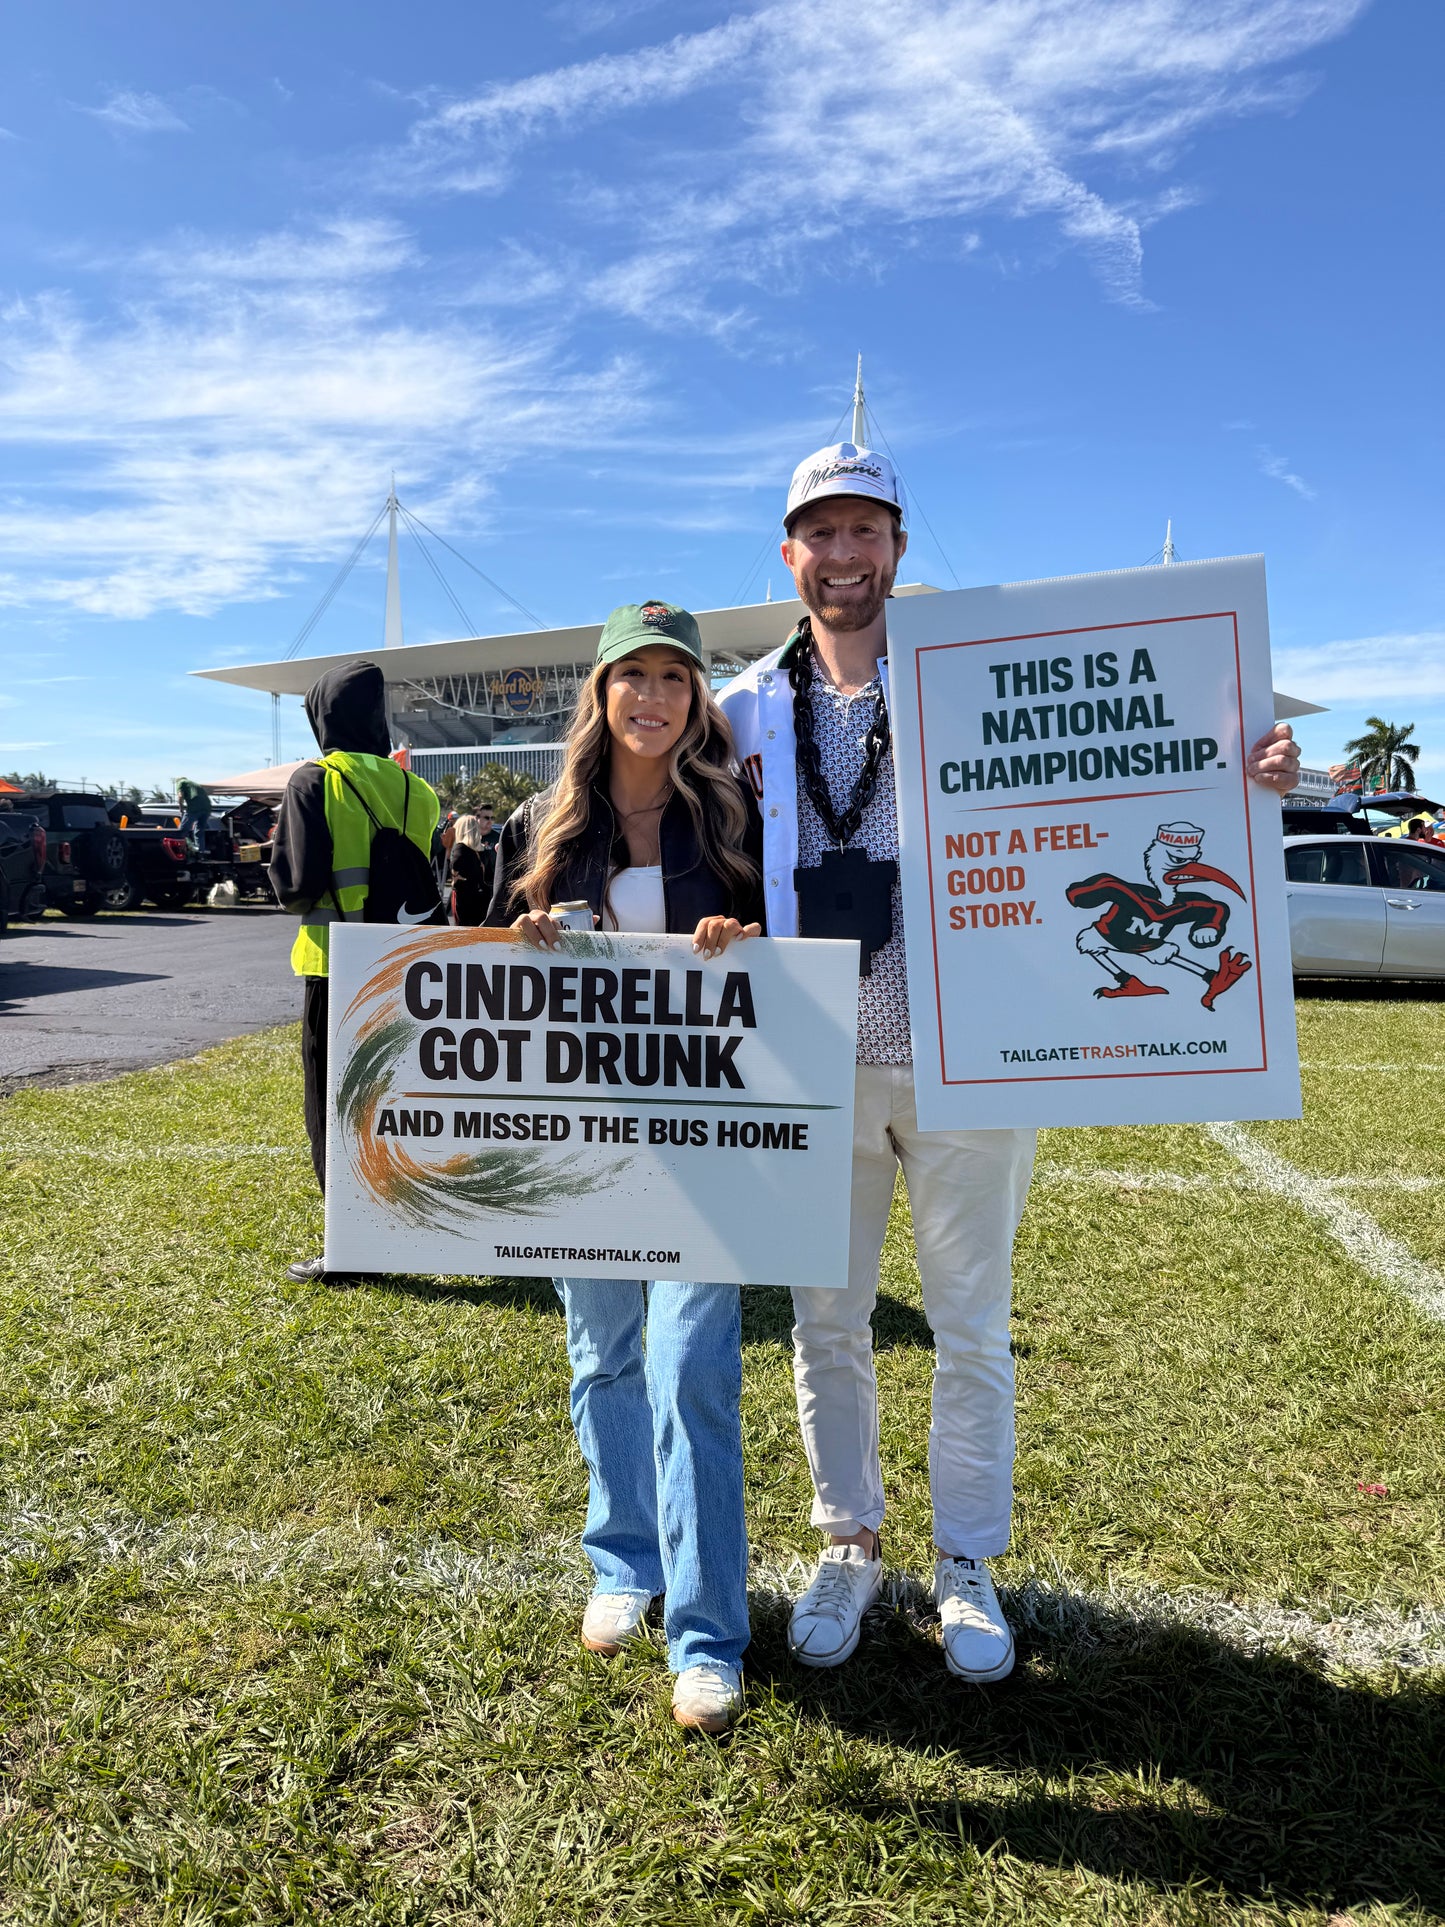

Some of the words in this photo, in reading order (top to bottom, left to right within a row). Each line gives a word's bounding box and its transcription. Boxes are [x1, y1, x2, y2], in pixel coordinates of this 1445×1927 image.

[491, 678, 517, 695] Hard
[518, 676, 544, 697] Rock
[989, 656, 1074, 699] THIS
[1083, 651, 1120, 690] IS
[1128, 647, 1157, 685] A
[981, 693, 1175, 746] NATIONAL
[939, 737, 1227, 795] CHAMPIONSHIP.
[945, 831, 1000, 859] NOT
[1008, 829, 1027, 854] A
[1034, 823, 1110, 852] FEEL-
[1159, 831, 1199, 845] MIAMI
[947, 866, 1025, 896] GOOD
[949, 900, 1042, 930] STORY.
[1125, 916, 1164, 939] M
[404, 961, 758, 1029] CINDERELLA
[419, 1026, 531, 1083] GOT
[545, 1030, 746, 1090] DRUNK
[999, 1040, 1228, 1064] TAILGATETRASHTALK.COM
[376, 1109, 444, 1138] AND
[453, 1111, 571, 1142] MISSED
[578, 1115, 640, 1144] THE
[648, 1117, 709, 1147] BUS
[716, 1120, 809, 1151] HOME
[494, 1245, 681, 1264] TAILGATETRASHTALK.COM
